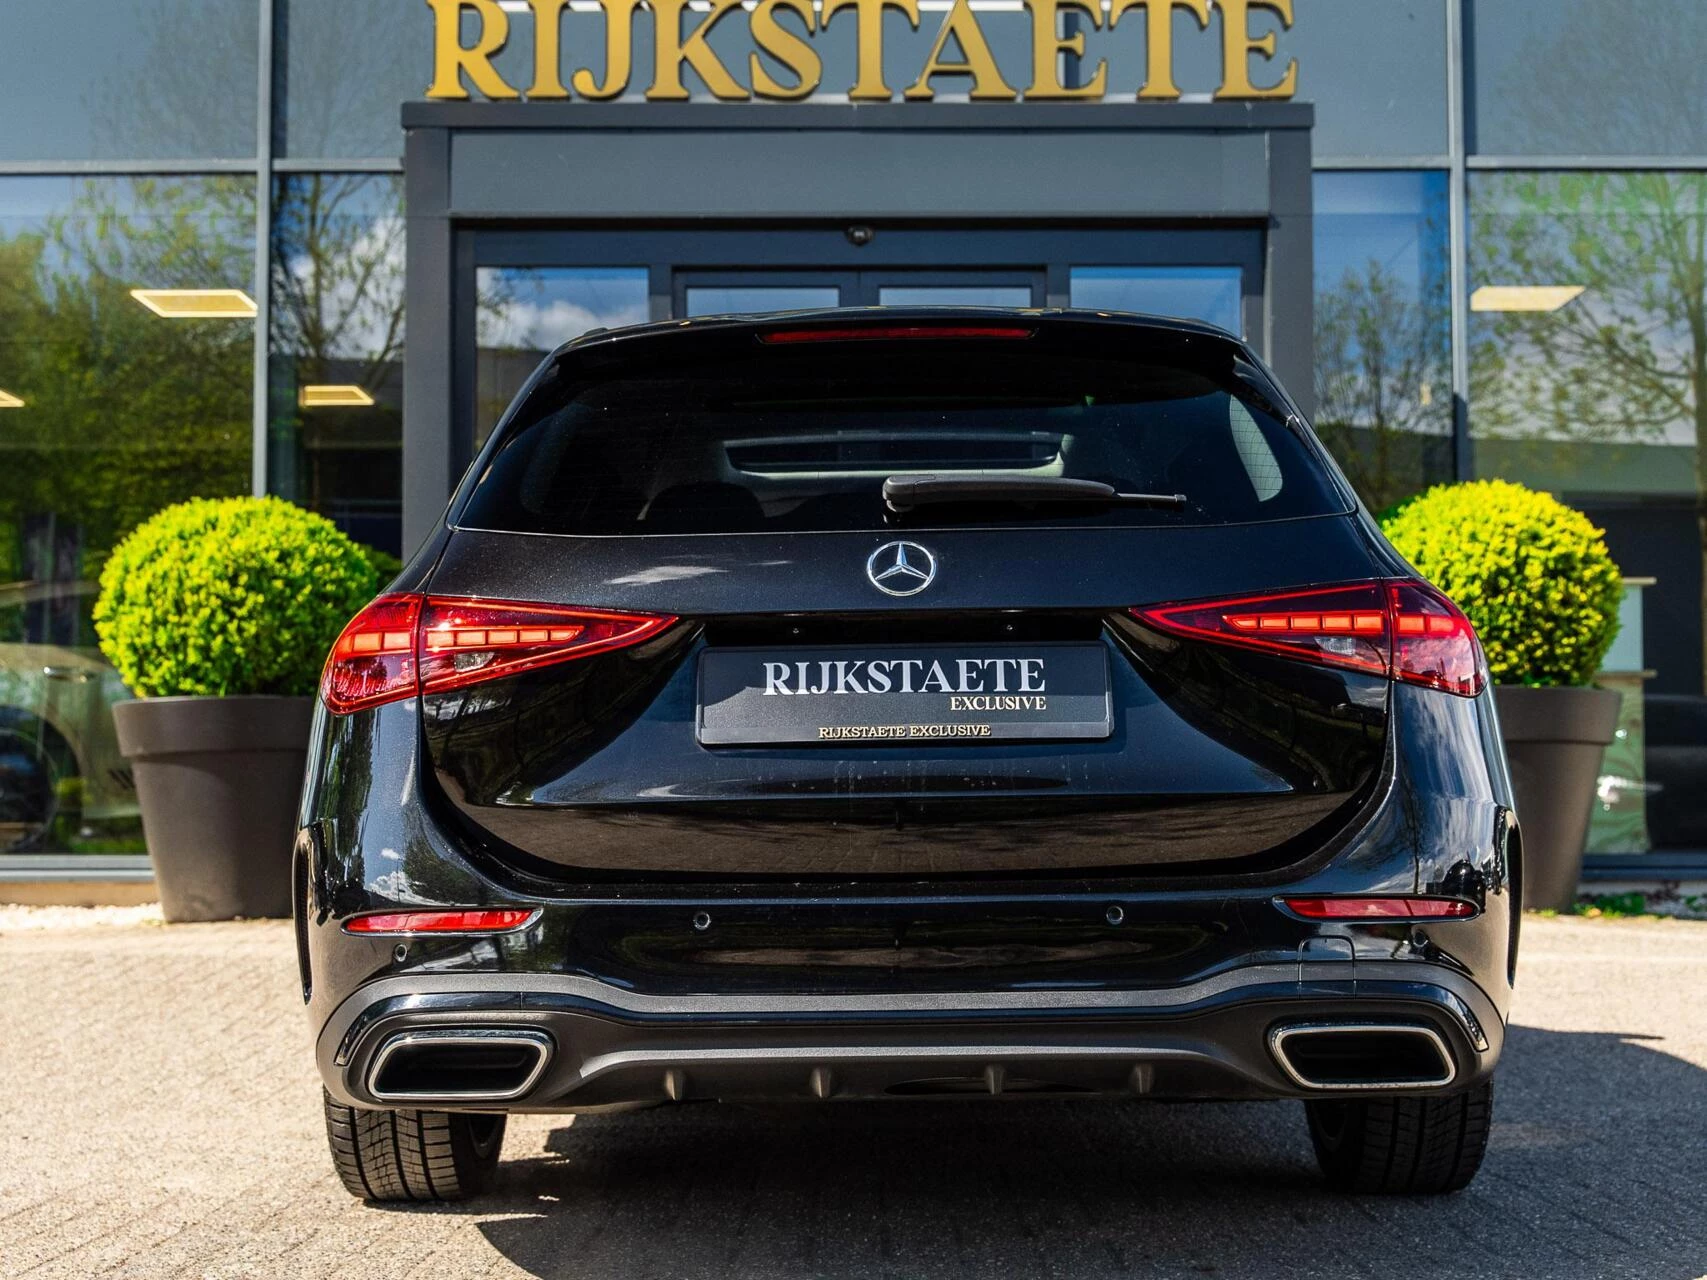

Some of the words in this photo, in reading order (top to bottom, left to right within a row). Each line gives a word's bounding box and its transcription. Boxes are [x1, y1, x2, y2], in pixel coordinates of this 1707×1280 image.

[424, 0, 1299, 101] RIJKSTAETE
[762, 658, 1047, 696] RIJKSTAETE
[950, 696, 1047, 711] EXCLUSIVE
[818, 726, 906, 739] RIJKSTAETE
[909, 724, 992, 737] EXCLUSIVE
